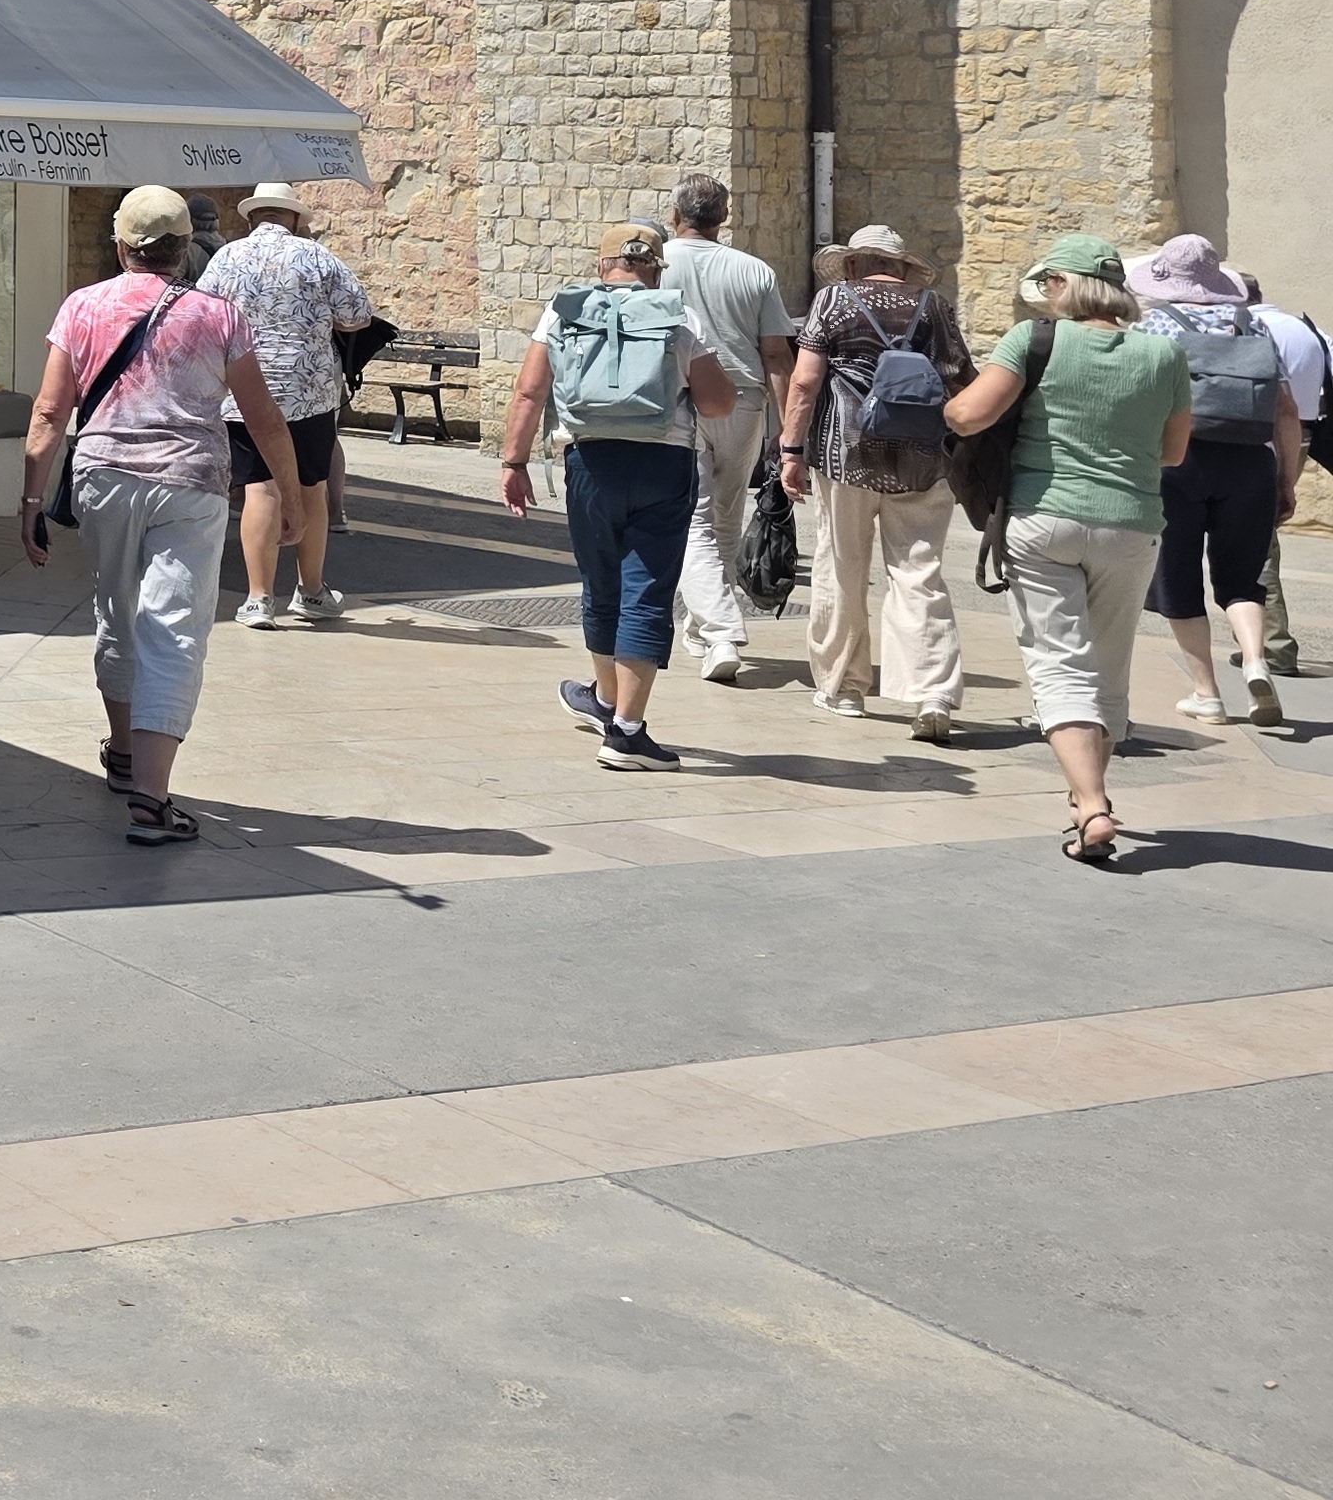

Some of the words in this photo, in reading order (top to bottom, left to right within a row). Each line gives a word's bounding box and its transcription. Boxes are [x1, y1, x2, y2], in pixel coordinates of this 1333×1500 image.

[27, 122, 109, 158] Boisset
[38, 160, 91, 182] Féminin
[182, 143, 242, 172] Styliste
